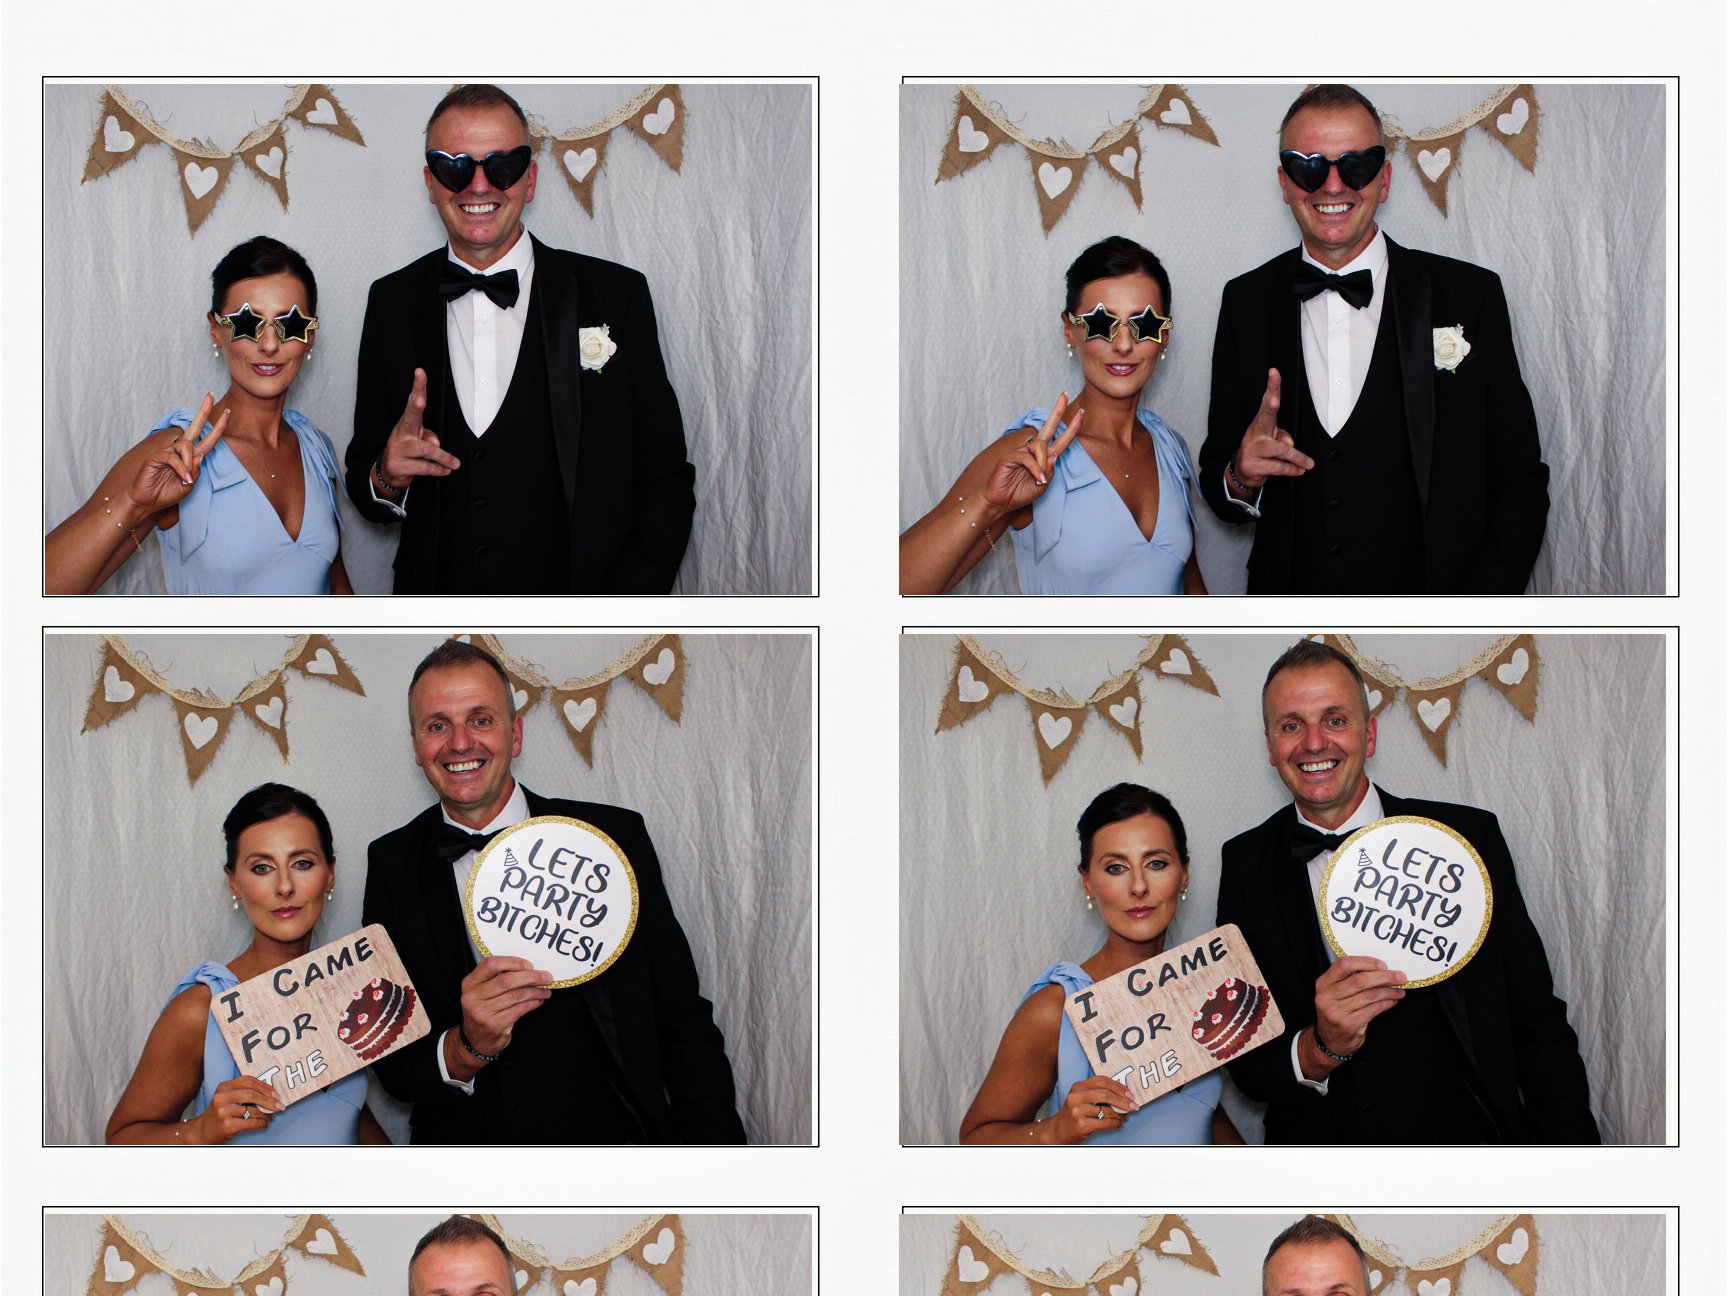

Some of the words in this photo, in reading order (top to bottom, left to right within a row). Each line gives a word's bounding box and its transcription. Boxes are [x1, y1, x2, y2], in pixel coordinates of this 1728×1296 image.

[528, 838, 610, 893] LETS
[1382, 838, 1464, 893] LETS
[500, 866, 608, 928] PARTY
[1354, 866, 1462, 928] PARTY
[477, 896, 604, 968] BITCHES!
[1331, 896, 1458, 968] BITCHES!
[220, 991, 244, 1023] I
[273, 936, 374, 997] CAME
[1074, 991, 1098, 1023] I
[1127, 936, 1228, 997] CAME
[241, 1012, 318, 1063] FOR
[1095, 1012, 1172, 1063] FOR
